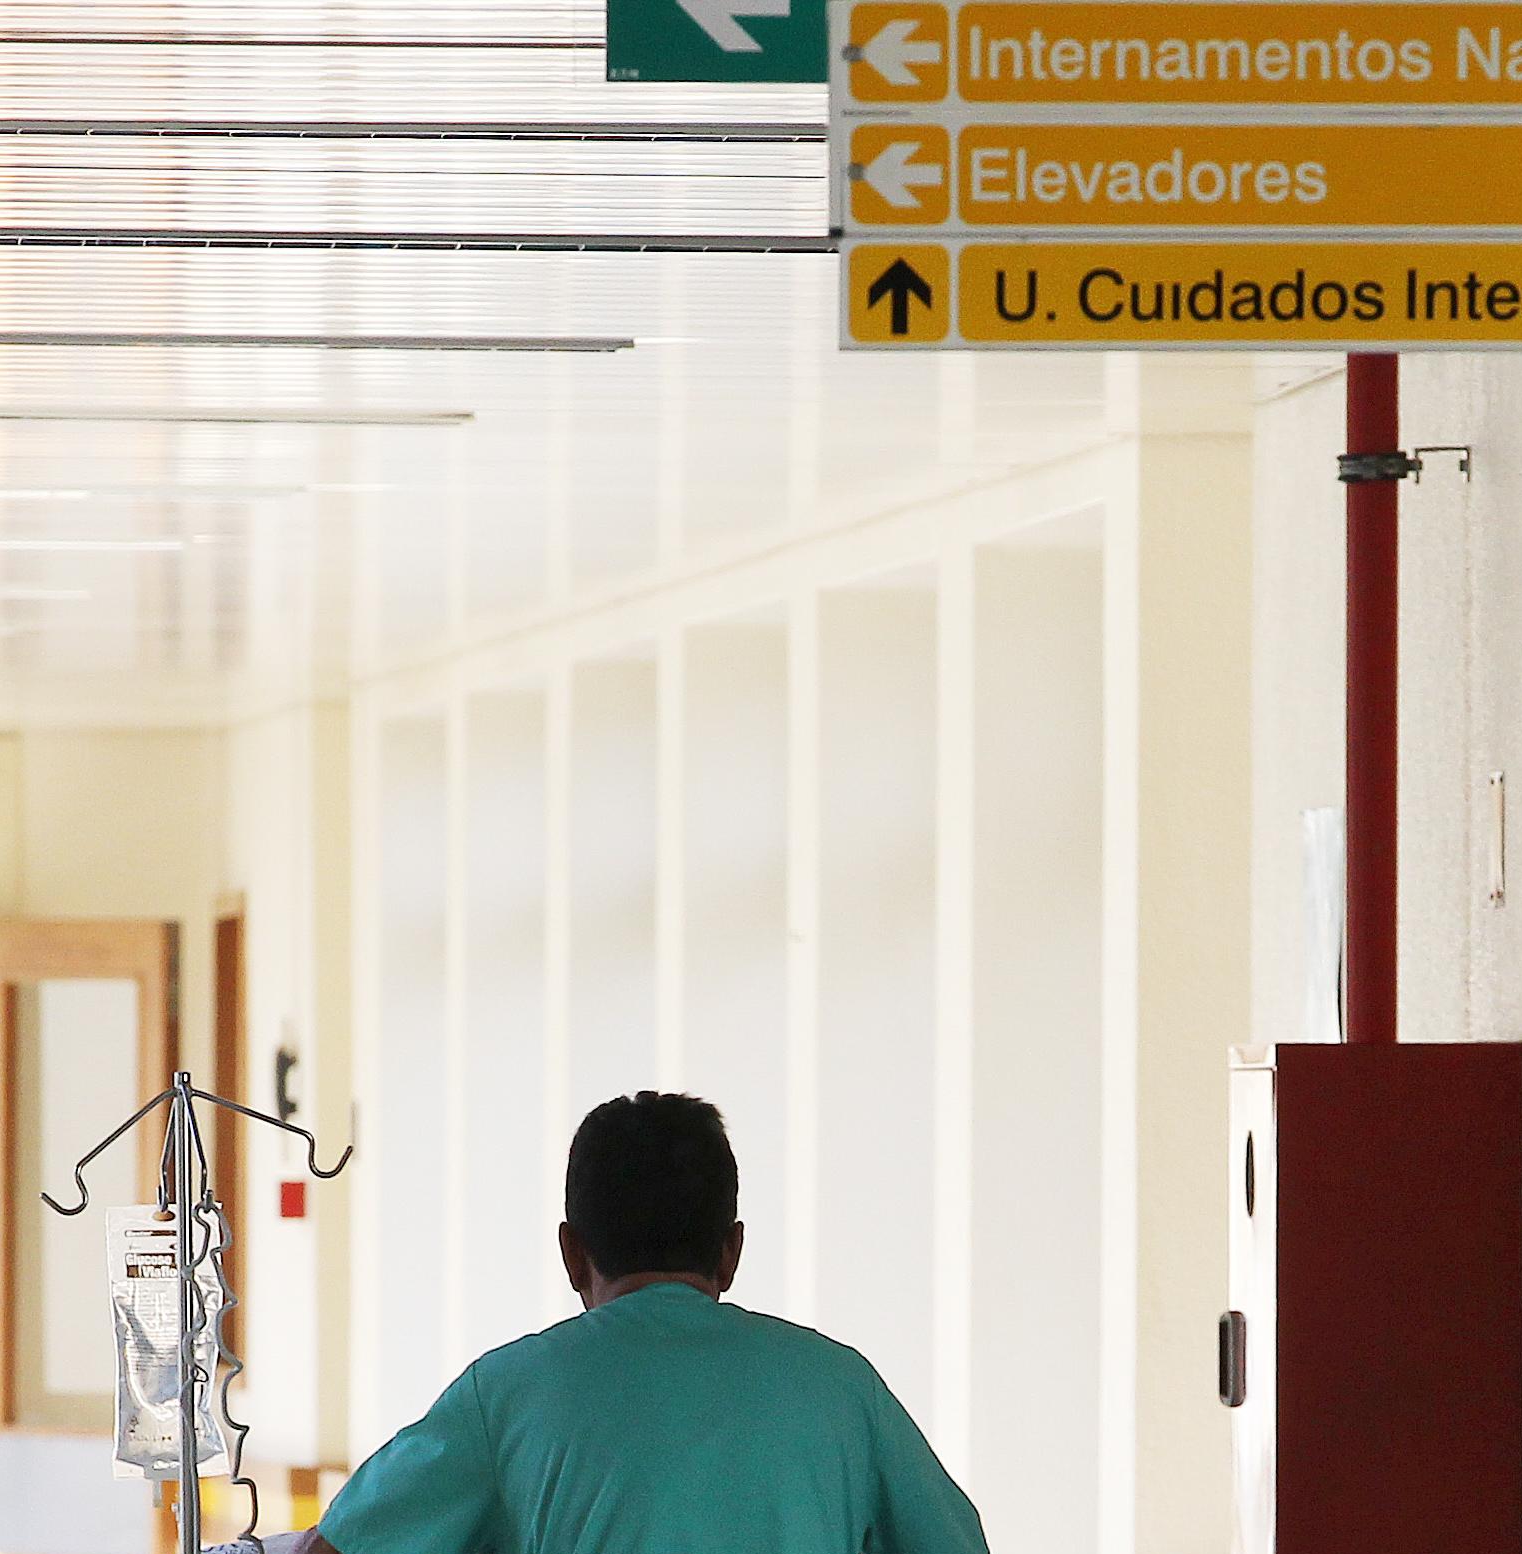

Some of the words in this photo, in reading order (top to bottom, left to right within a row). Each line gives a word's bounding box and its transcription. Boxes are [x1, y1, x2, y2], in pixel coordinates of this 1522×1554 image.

[969, 27, 1433, 82] Internamentos
[971, 146, 1329, 205] Elevadores
[993, 270, 1057, 324] U.
[1078, 268, 1387, 325] Cuidados
